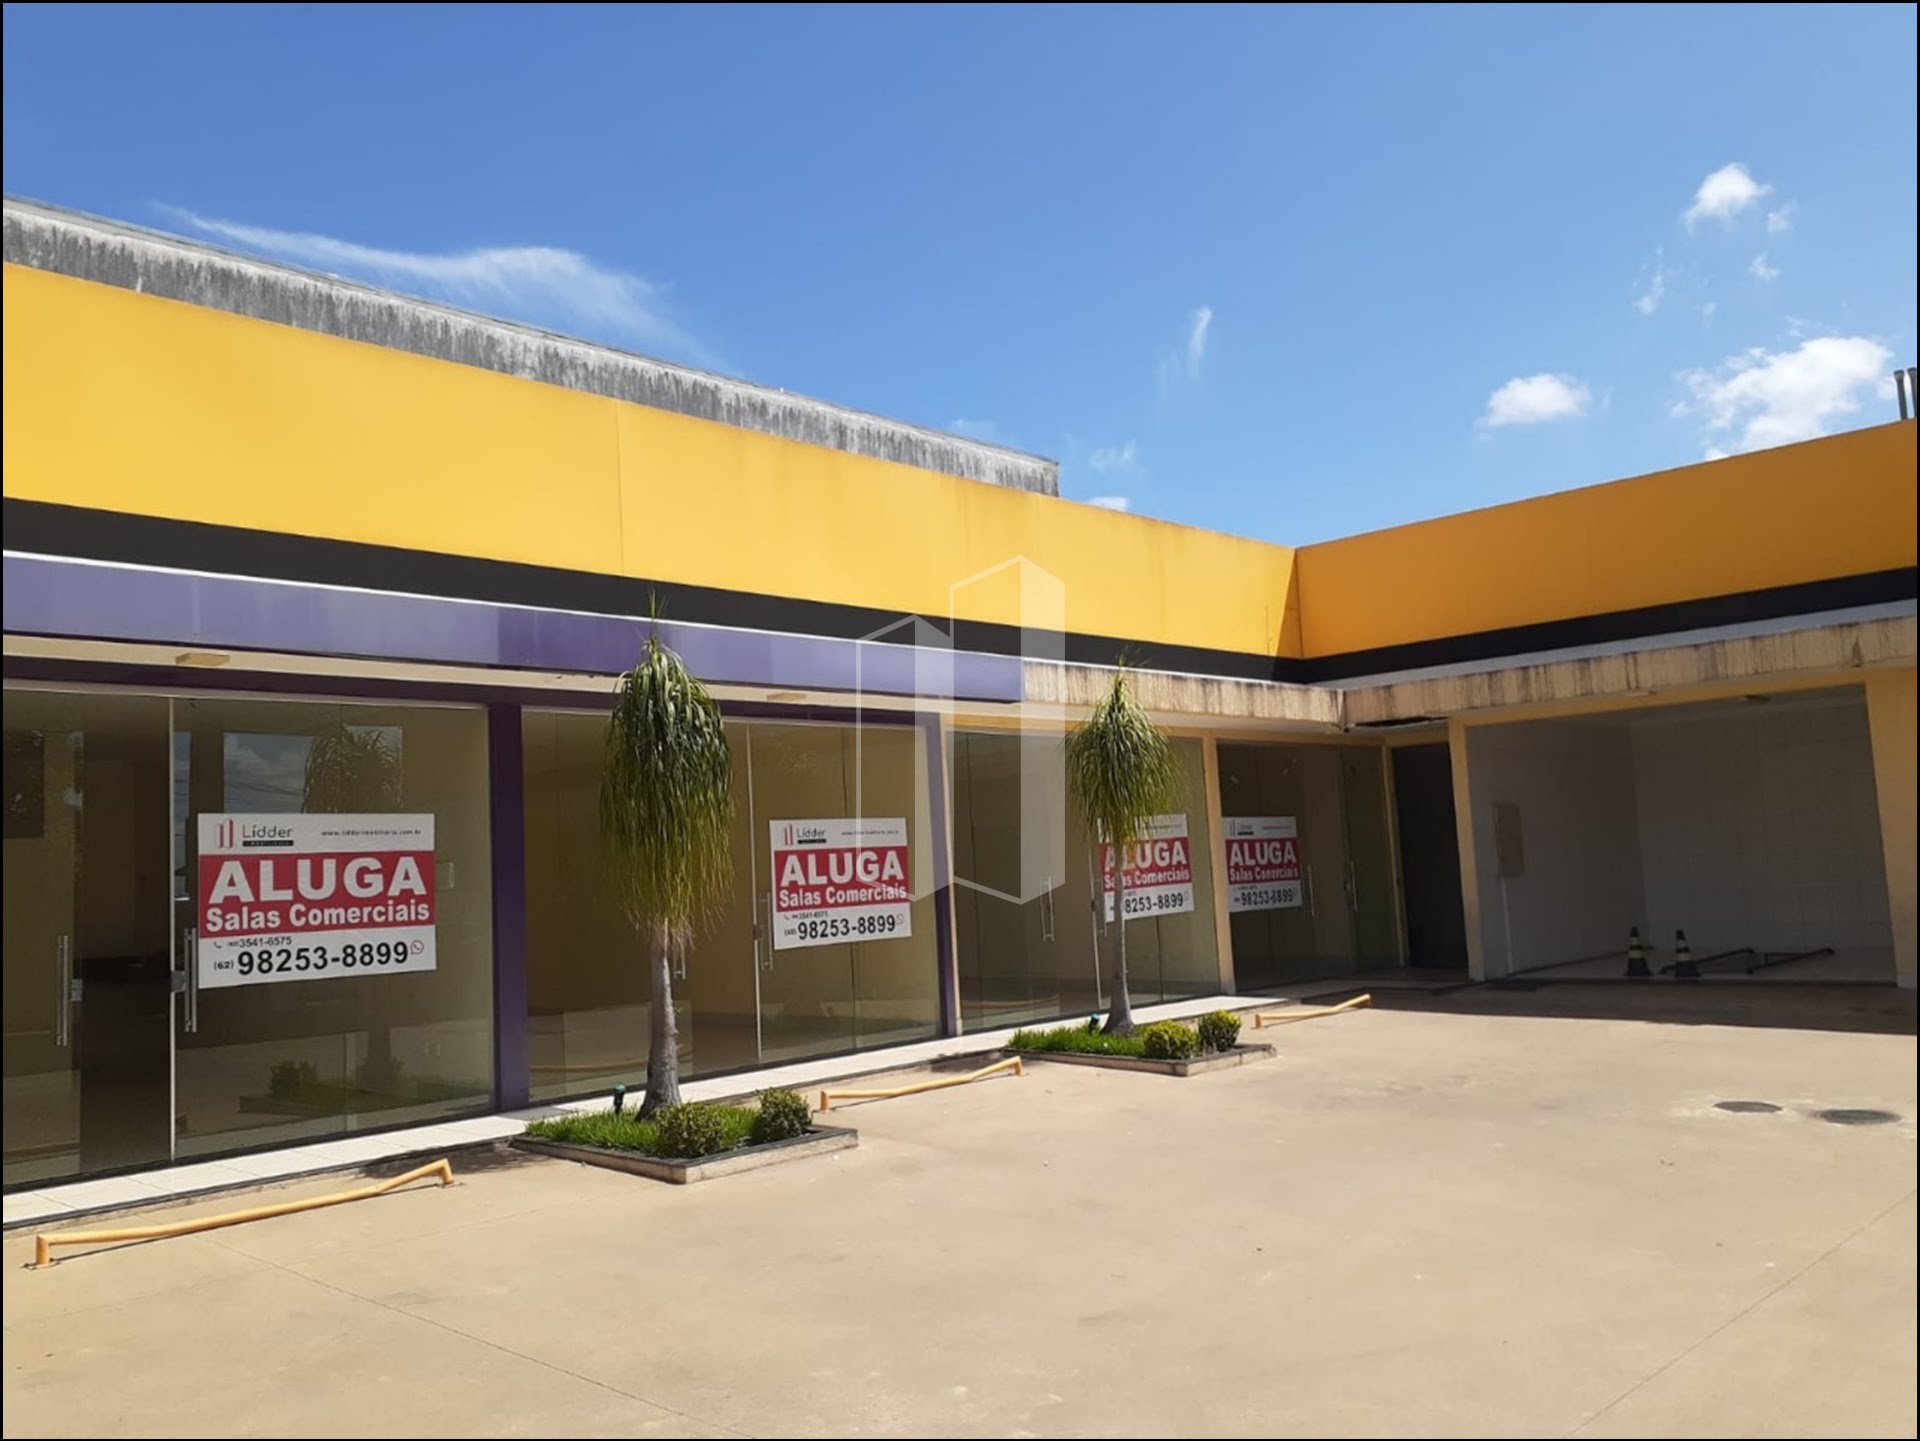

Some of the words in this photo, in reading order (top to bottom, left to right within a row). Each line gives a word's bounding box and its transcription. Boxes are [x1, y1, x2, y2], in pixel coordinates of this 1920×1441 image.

[1229, 841, 1297, 867] ALUGA
[208, 856, 428, 904] ALUGA
[780, 850, 904, 887] ALUGA
[1134, 867, 1189, 885] Comerciais
[1230, 868, 1253, 882] Salas
[779, 889, 821, 908] Salas
[825, 883, 907, 904] Comerciais
[1124, 892, 1184, 914] 8253-8899
[206, 907, 281, 932] Salas
[289, 899, 430, 927] Comerciais
[797, 914, 896, 940] 98253-8899
[214, 960, 234, 971] (62)
[237, 941, 410, 976] 98253-8899
